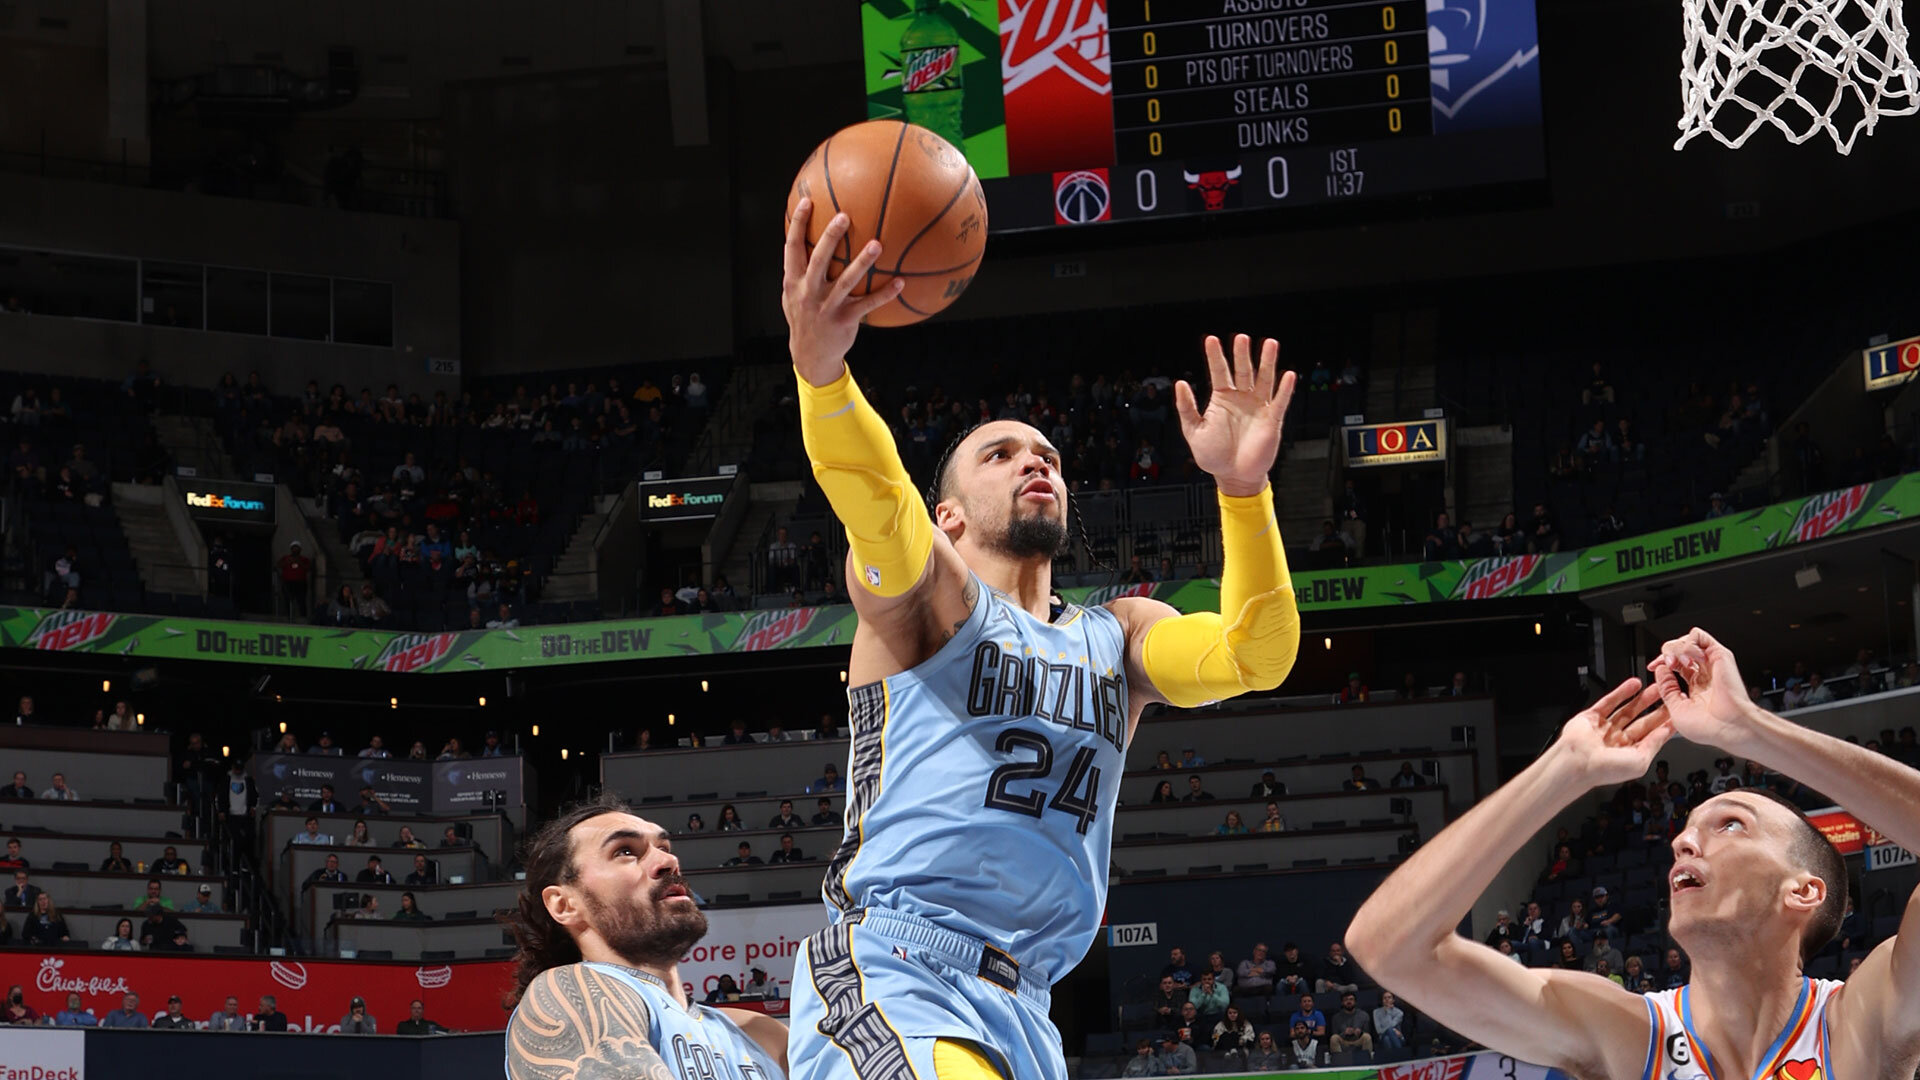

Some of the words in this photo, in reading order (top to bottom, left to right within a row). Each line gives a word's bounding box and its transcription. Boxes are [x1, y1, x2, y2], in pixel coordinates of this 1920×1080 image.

[1143, 32, 1156, 55] 0
[1206, 13, 1329, 49] TURNOVERS
[1382, 6, 1396, 31] 0
[1145, 65, 1158, 89] 0
[1186, 60, 1218, 86] PTS
[1221, 54, 1250, 82] OFF
[1255, 45, 1354, 79] TURNOVERS
[1384, 40, 1398, 65] 0
[1147, 99, 1160, 122] 0
[1234, 83, 1309, 115] STEALS
[1386, 74, 1399, 98] 0
[1150, 132, 1162, 156] 0
[1238, 117, 1309, 148] DUNKS
[1388, 108, 1401, 132] 0
[1136, 169, 1157, 211] 0
[1267, 156, 1289, 199] 0
[1326, 171, 1364, 197] 11:37
[435, 360, 454, 372] 215
[1878, 343, 1920, 375] IO
[1358, 427, 1434, 453] IOA
[187, 492, 265, 511] FedExForum
[648, 493, 724, 509] FedExForum
[1616, 545, 1645, 574] DO
[1673, 527, 1724, 560] DEW
[1312, 576, 1367, 601] DEW
[195, 629, 228, 654] DO
[258, 633, 312, 659] DEW
[601, 628, 653, 653] DEW
[966, 640, 1126, 754] GRIZZLIES
[298, 768, 334, 780] Hennessy
[386, 773, 422, 785] Hennessy
[472, 770, 507, 782] Hennessy
[983, 727, 1102, 837] 24
[1116, 926, 1153, 944] 107A
[678, 944, 737, 964] core
[745, 935, 801, 966] poin
[36, 957, 129, 996] Chick-fil-A
